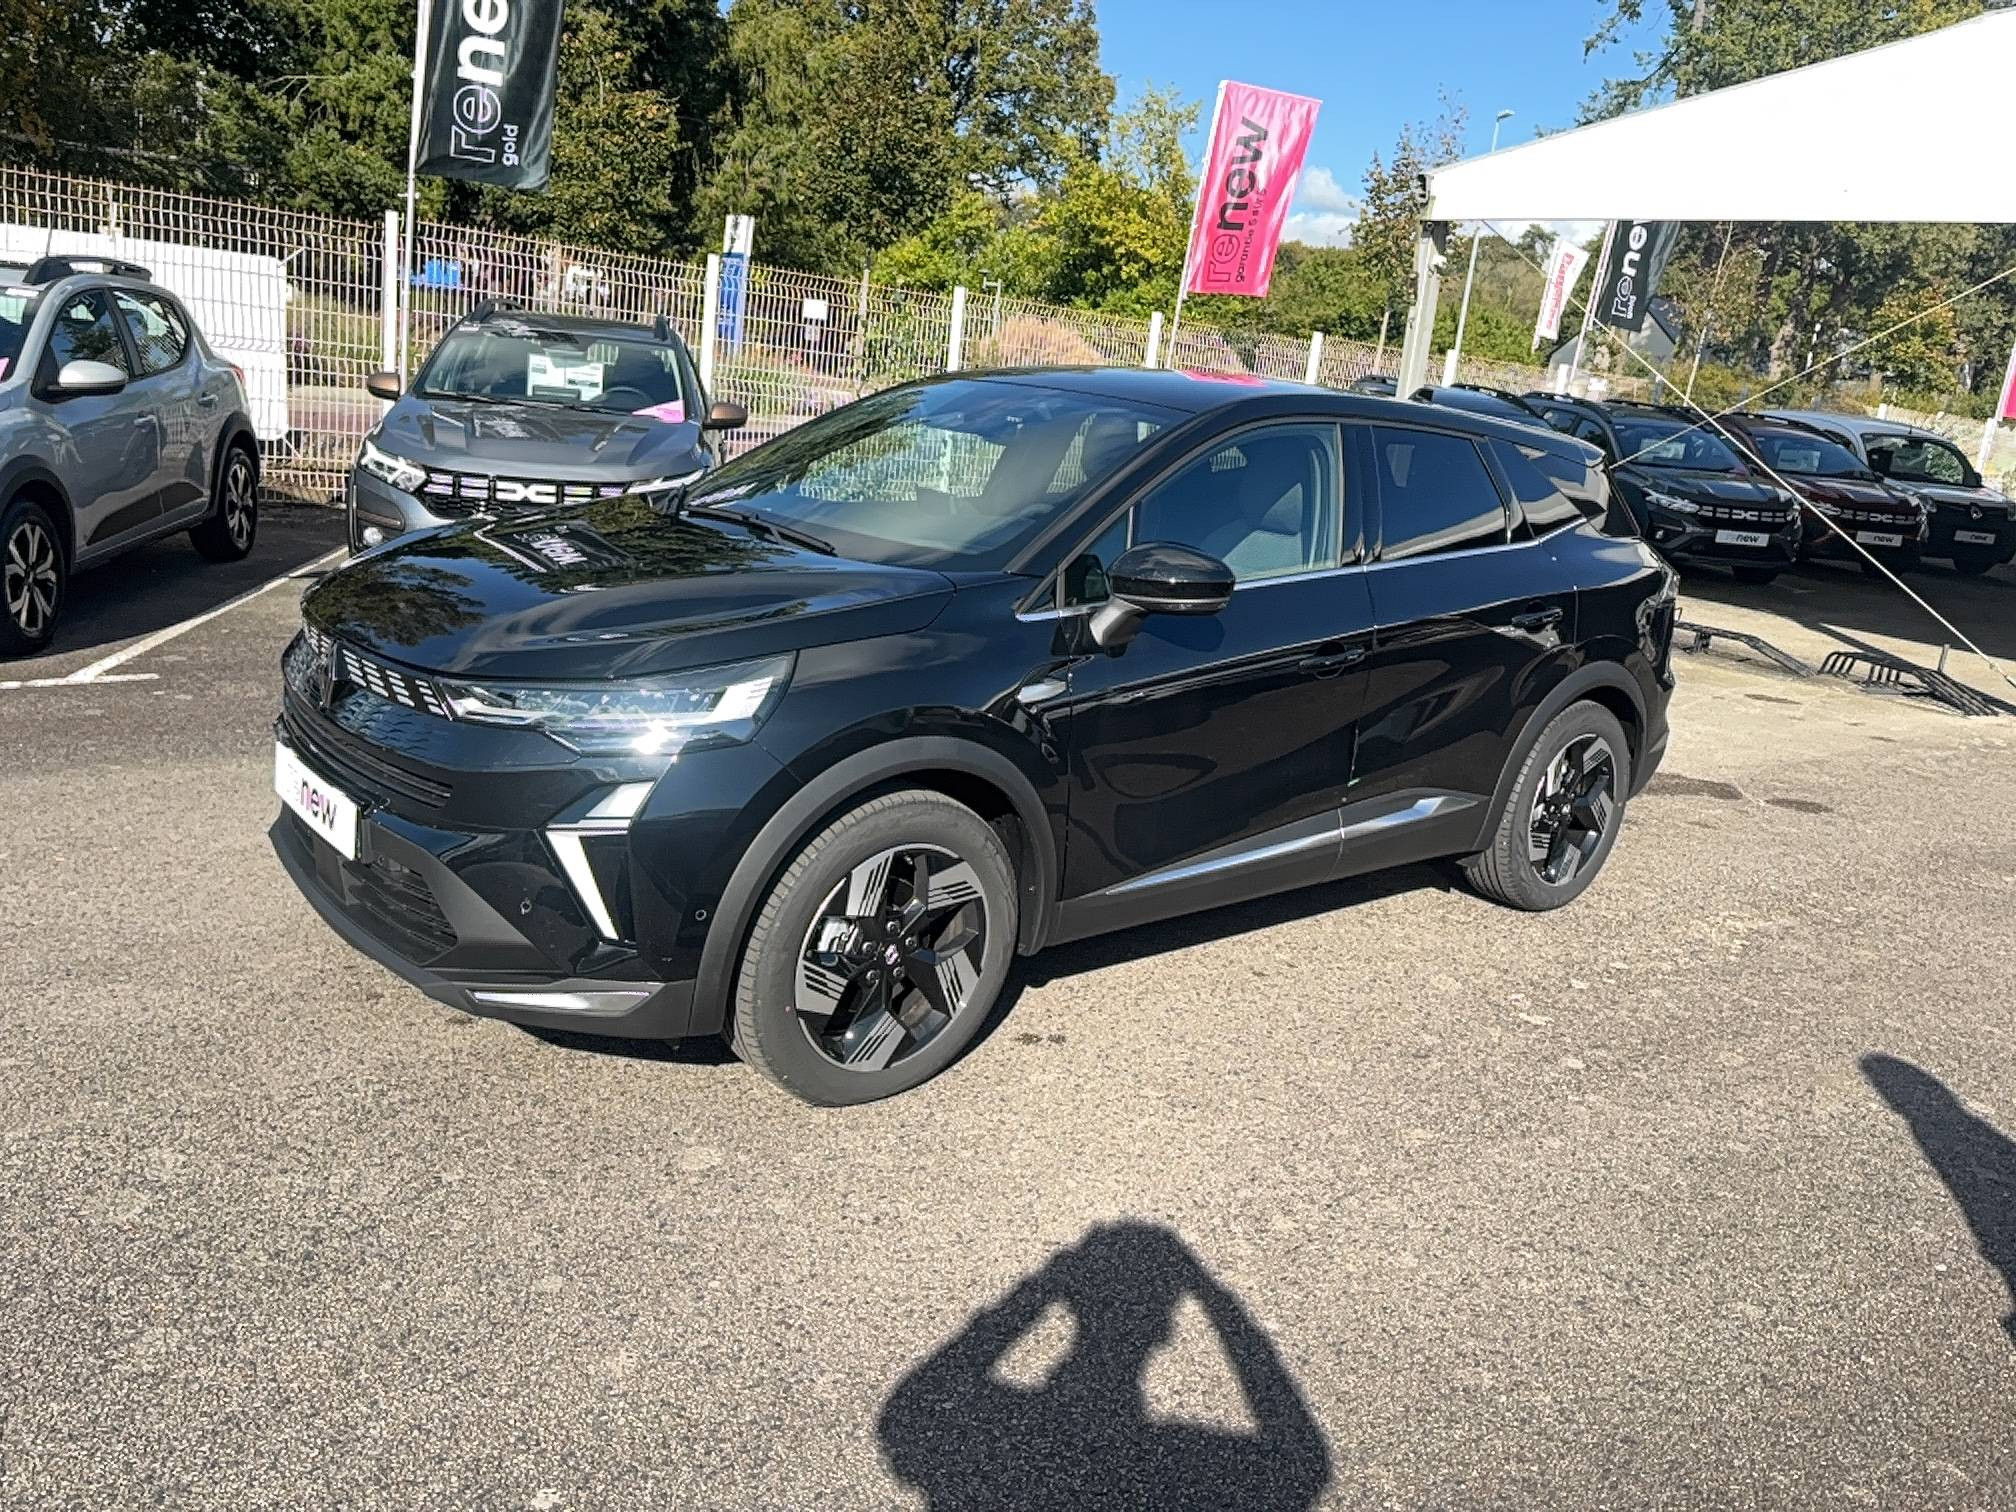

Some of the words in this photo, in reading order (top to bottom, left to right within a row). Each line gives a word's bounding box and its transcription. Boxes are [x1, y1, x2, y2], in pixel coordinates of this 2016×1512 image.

[502, 124, 519, 167] gold
[1206, 116, 1269, 283] renew
[1236, 229, 1255, 283] garantie
